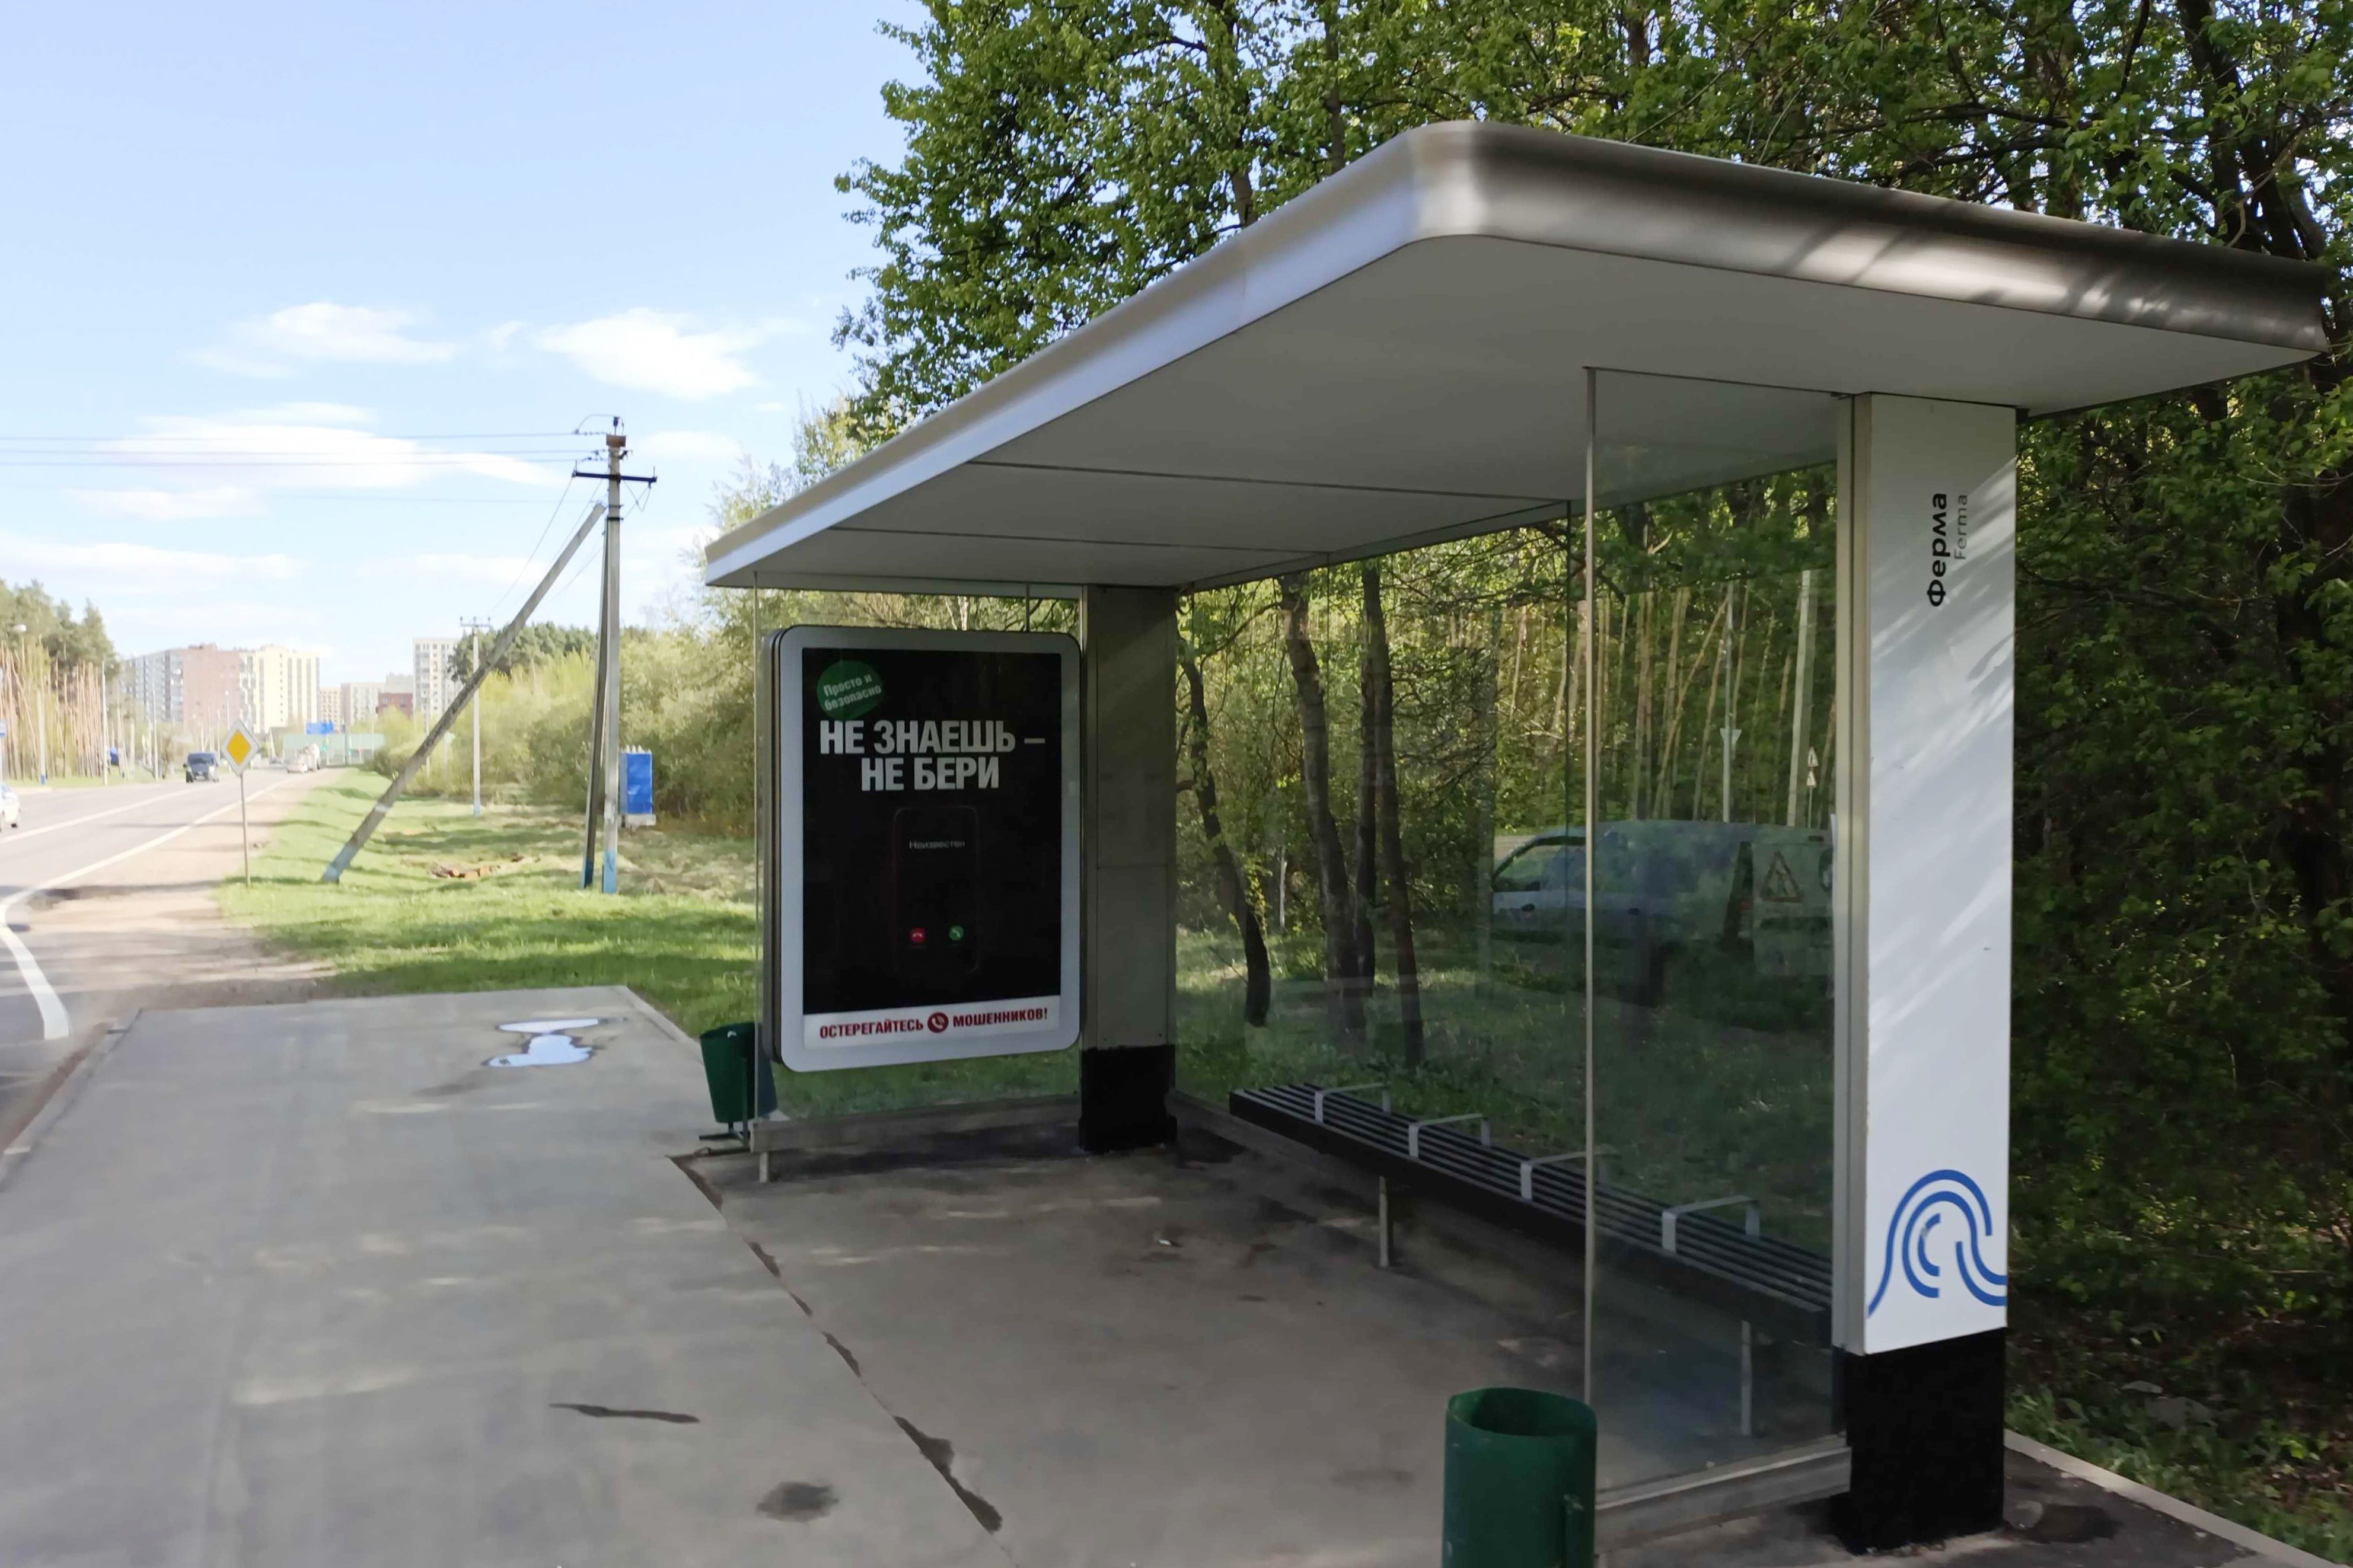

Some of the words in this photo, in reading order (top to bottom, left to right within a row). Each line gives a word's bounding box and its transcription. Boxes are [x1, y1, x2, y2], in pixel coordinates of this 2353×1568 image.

[1955, 494, 1968, 560] Ferma
[1926, 493, 1950, 606] Ферма
[823, 677, 863, 697] Просто
[864, 673, 872, 684] и
[824, 685, 882, 711] безопасно
[820, 720, 865, 754] НЕ
[873, 720, 1016, 753] ЗНАЕШЬ
[861, 757, 904, 791] НЕ
[914, 756, 999, 790] БЕРИ
[820, 1018, 923, 1039] ОСТЕРЕГАЙТЕСЬ
[953, 1008, 1048, 1027] МОШЕННИКОВ!
